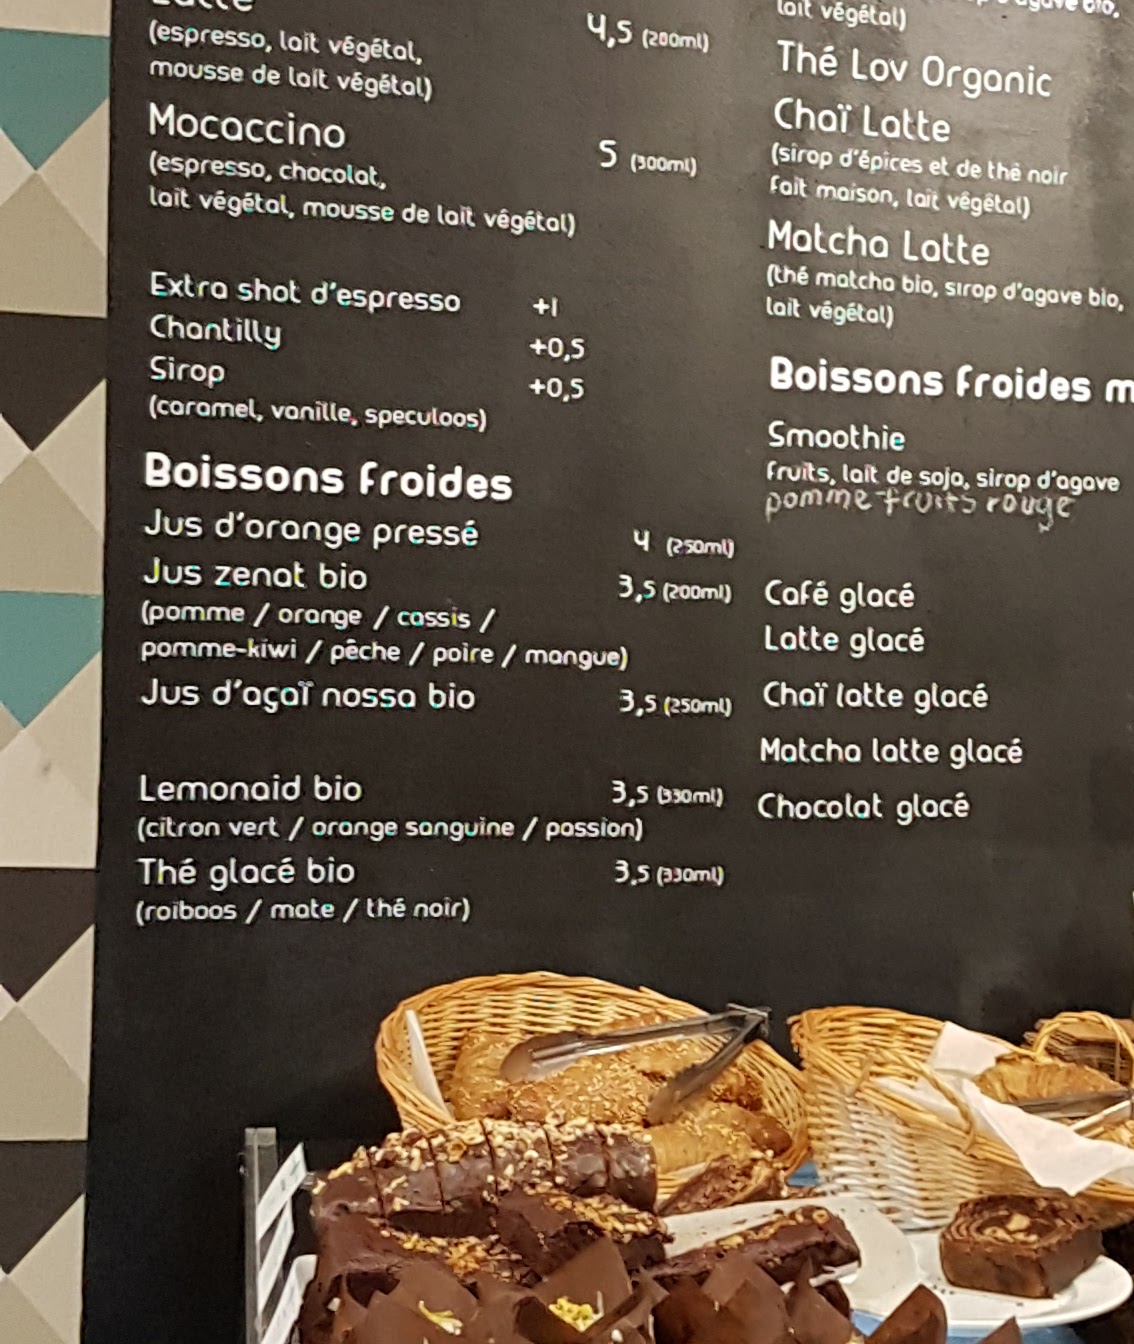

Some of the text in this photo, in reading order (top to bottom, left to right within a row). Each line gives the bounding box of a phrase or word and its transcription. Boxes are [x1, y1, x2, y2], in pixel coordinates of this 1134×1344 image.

[776, 39, 1052, 99] Thé Lov Organic
[149, 101, 346, 149] Mocaccino
[774, 97, 951, 143] Chaï Latte
[149, 149, 387, 191] (espresso, chocolat,
[768, 218, 990, 266] Matcha Latte
[150, 270, 461, 315] Extra shot d'espresso
[532, 296, 558, 318] +1
[149, 313, 282, 351] Chantilly
[529, 337, 585, 363] +0,5
[149, 355, 225, 389] Sirop
[769, 355, 944, 396] Boissons
[956, 364, 1092, 403] froides
[528, 377, 585, 403] +0,5
[148, 393, 487, 433] (caramel, vanille, speculoos)
[768, 420, 906, 452] Smoothie
[144, 451, 513, 502] Boissons froides
[766, 460, 1121, 496] fruits, lait de soja, sirop d'agave
[764, 488, 873, 523] pomme
[985, 493, 1076, 533] rouge
[143, 507, 479, 551] Jus d'orange pressé
[142, 556, 368, 590] Jus zenat bio
[618, 573, 732, 605] 3,5 (200ml)
[764, 579, 915, 614] Café glacé
[140, 599, 471, 631] (pomme orange cassis
[140, 637, 629, 672] pomme-kiwi pêche poire mangue)
[764, 624, 925, 659] Latte glacé
[140, 677, 201, 706] Jus
[321, 687, 417, 708] nossa
[428, 681, 476, 710] bio
[762, 680, 989, 715] Chaï latte glacé
[760, 737, 1023, 770] Matcha latte glacé
[139, 773, 363, 802] Lemonaid bio
[757, 791, 970, 826] Chocolat glacé
[137, 816, 643, 843] (citron vert orange sanguine passion)
[135, 855, 355, 892] Thé glacé bio
[270, 898, 335, 920] mate
[366, 897, 407, 918] thé
[412, 896, 471, 923] noir)
